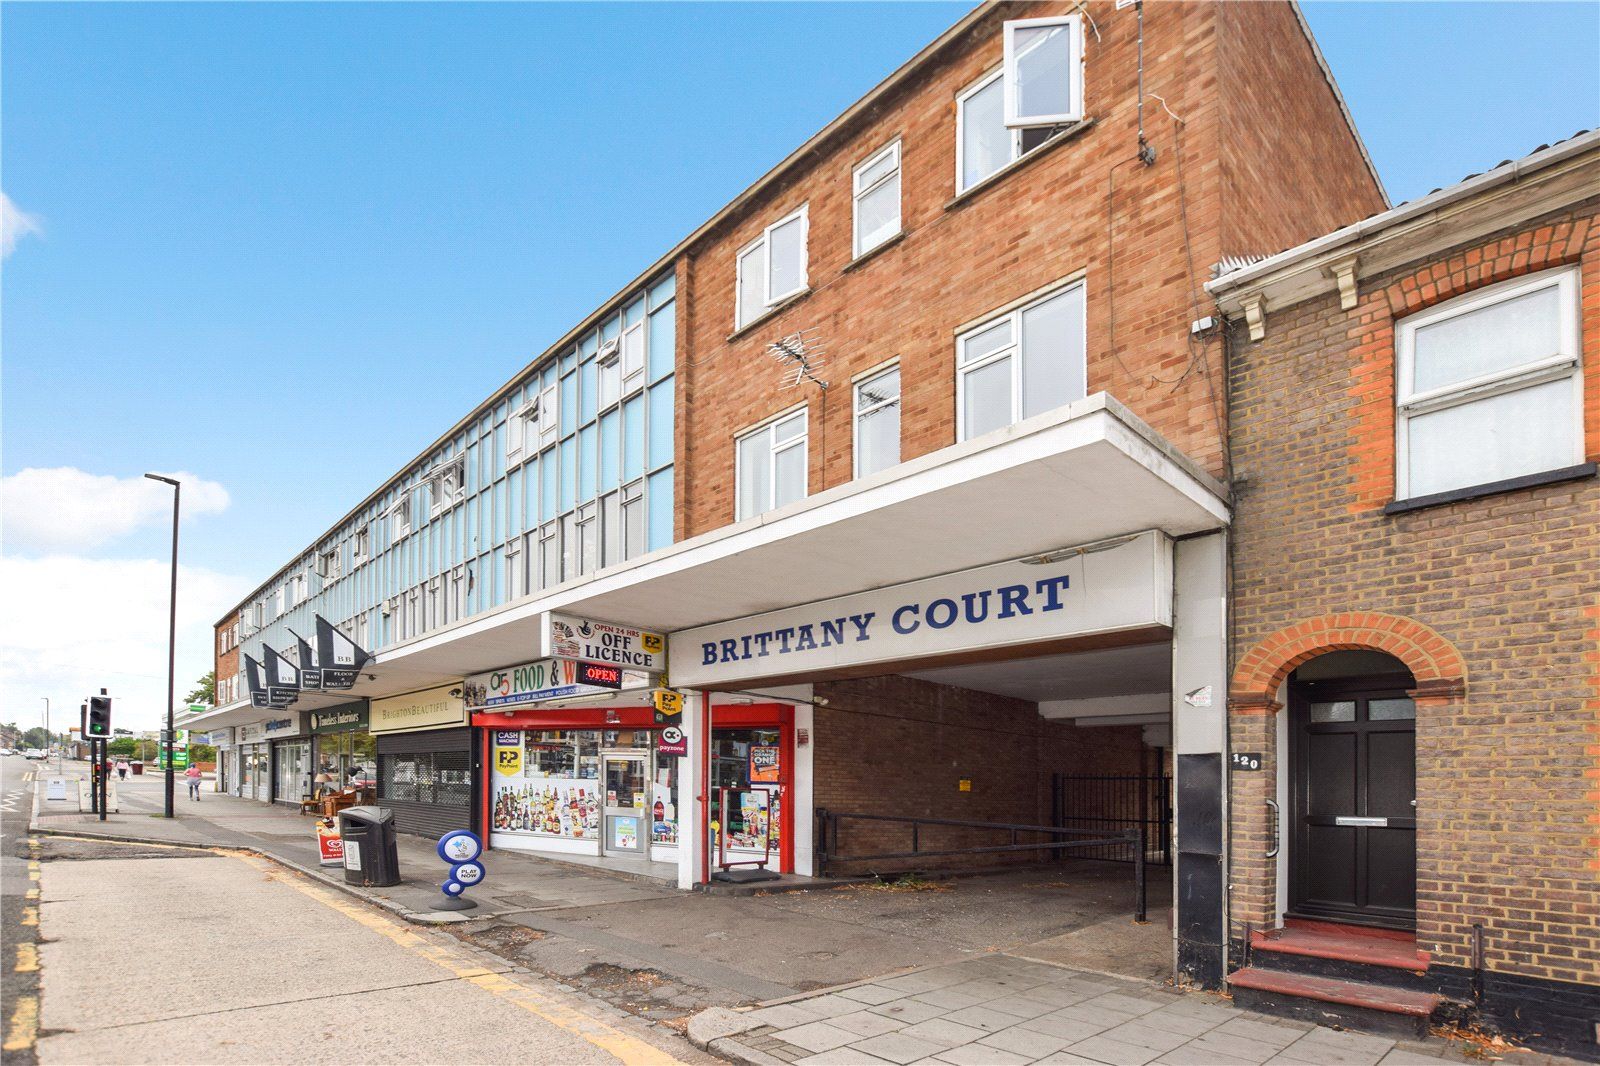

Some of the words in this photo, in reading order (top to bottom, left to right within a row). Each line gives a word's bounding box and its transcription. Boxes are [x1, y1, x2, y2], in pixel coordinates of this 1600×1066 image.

[701, 612, 876, 666] BRITTANY
[891, 574, 1070, 635] COURT
[594, 623, 613, 633] OPEN
[615, 627, 625, 635] 24
[626, 630, 640, 638] HRS
[601, 633, 631, 650] OFF
[585, 644, 653, 667] LICENCE
[513, 664, 545, 693] FOOD
[550, 660, 560, 687] &
[587, 668, 617, 682] OPEN
[498, 731, 518, 739] CASH
[754, 756, 776, 765] ONE
[1233, 753, 1258, 769] 120
